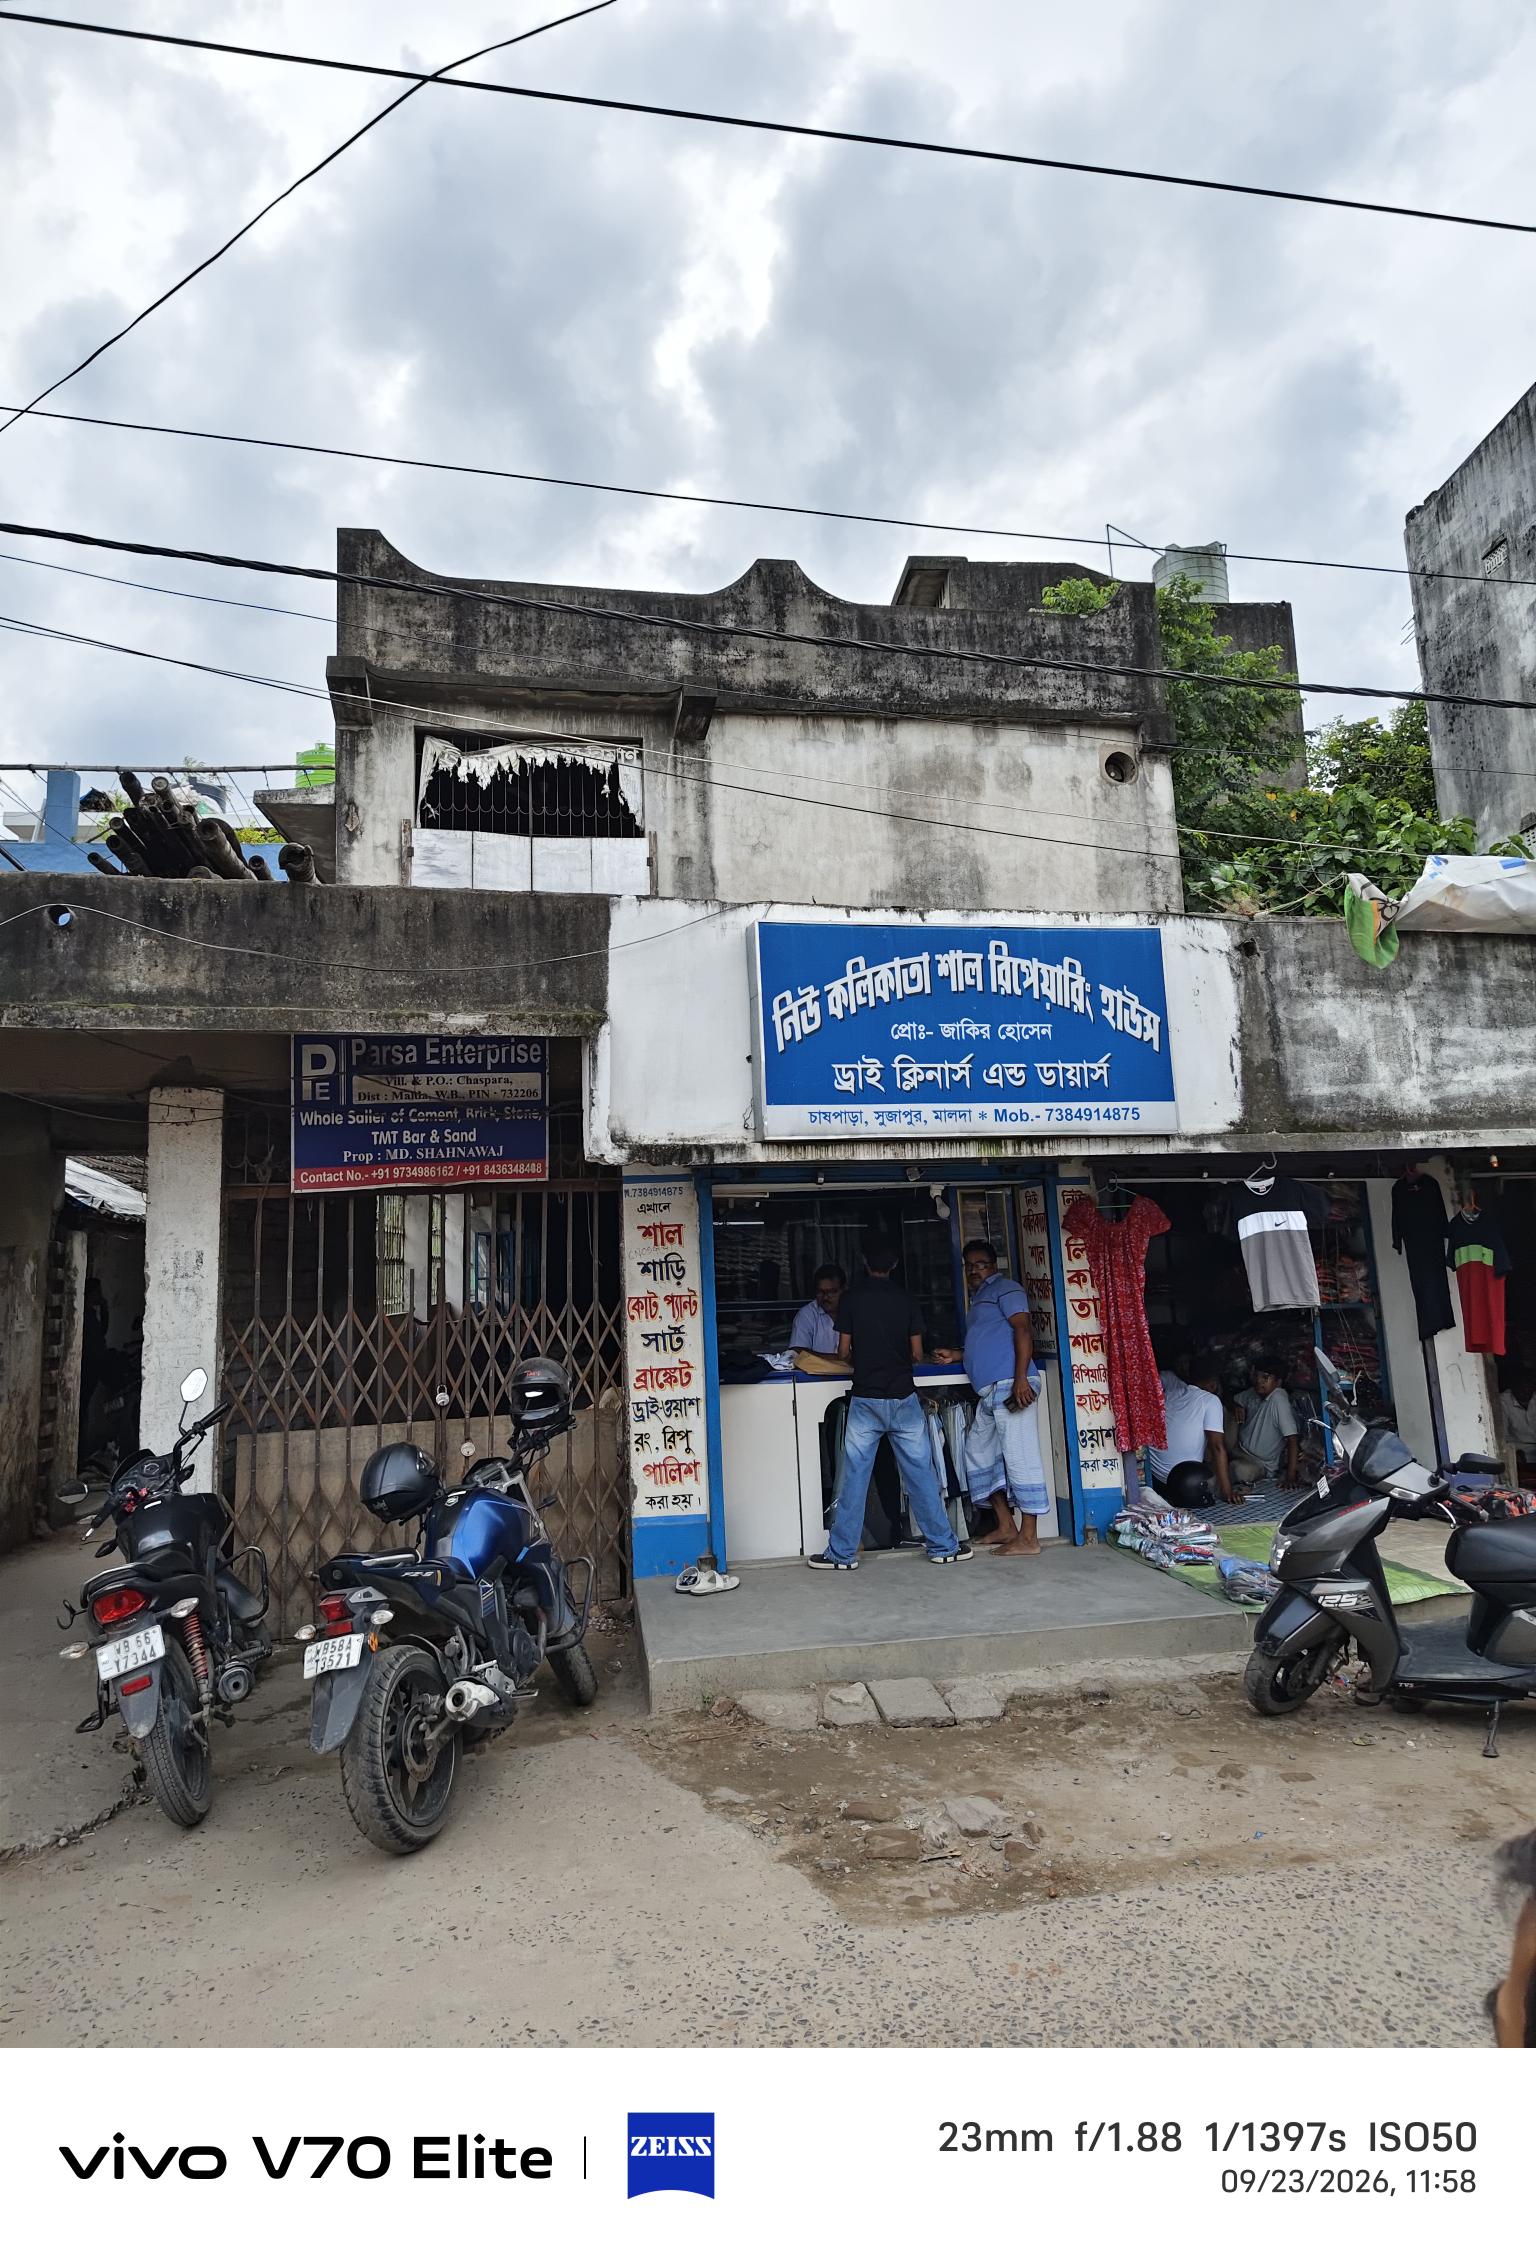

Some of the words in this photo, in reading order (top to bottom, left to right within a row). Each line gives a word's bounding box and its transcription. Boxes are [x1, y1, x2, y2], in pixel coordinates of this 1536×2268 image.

[772, 985, 822, 1053] নিউ
[824, 952, 932, 1020] কলিকাতা
[935, 949, 984, 992] শাল
[988, 940, 1094, 1024] রিপেয়ারিং
[1099, 985, 1161, 1053] হাউস
[938, 1018, 991, 1041] জাকির
[998, 1022, 1052, 1043] হোসেন
[351, 1038, 417, 1066] Parsa
[425, 1037, 542, 1070] Enterprise
[411, 1076, 422, 1086] &
[456, 1075, 513, 1087] Chaspara,
[832, 1054, 886, 1094] ড্রাই
[891, 1053, 974, 1091] ক্লিনার্স
[982, 1063, 1027, 1089] এন্ড
[1034, 1053, 1111, 1089] ডায়ার্স
[358, 1091, 380, 1101] Dist
[468, 1089, 490, 1099] PIN
[500, 1088, 539, 1098] 732206
[300, 1111, 343, 1126] Whole
[390, 1108, 405, 1123] of
[408, 1107, 462, 1124] Cement,
[808, 1109, 869, 1127] চাষপাড়া,
[874, 1109, 928, 1127] সুজাপুর,
[932, 1108, 972, 1123] মালদা
[994, 1108, 1040, 1122] Mob.-
[1045, 1107, 1140, 1122] 7384914875
[372, 1131, 398, 1146] TMT
[402, 1131, 426, 1145] Bar
[429, 1130, 440, 1144] &
[444, 1128, 477, 1143] Sand
[343, 1150, 374, 1165] Prop
[385, 1149, 413, 1161] MD.
[416, 1145, 504, 1160] SHAHNAWAJ
[300, 1171, 344, 1184] Contact
[371, 1167, 390, 1179] +91
[392, 1165, 454, 1179] 9734986162
[462, 1164, 480, 1176] +91
[637, 1202, 671, 1214] এখানে
[637, 1221, 684, 1247] শাল
[637, 1252, 686, 1286] শাড়ি
[663, 1287, 698, 1321] প্যান্ট
[641, 1324, 686, 1352] সার্ট
[1069, 1332, 1104, 1353] শাল
[1071, 1363, 1109, 1384] রিপিয়ারি
[1076, 1389, 1111, 1416] হাউস
[662, 1425, 696, 1455] রিপু
[1079, 1425, 1117, 1448] ওয়াশ
[642, 1456, 701, 1486] পালিশ
[1080, 1458, 1100, 1472] করা
[645, 1495, 668, 1510] করা
